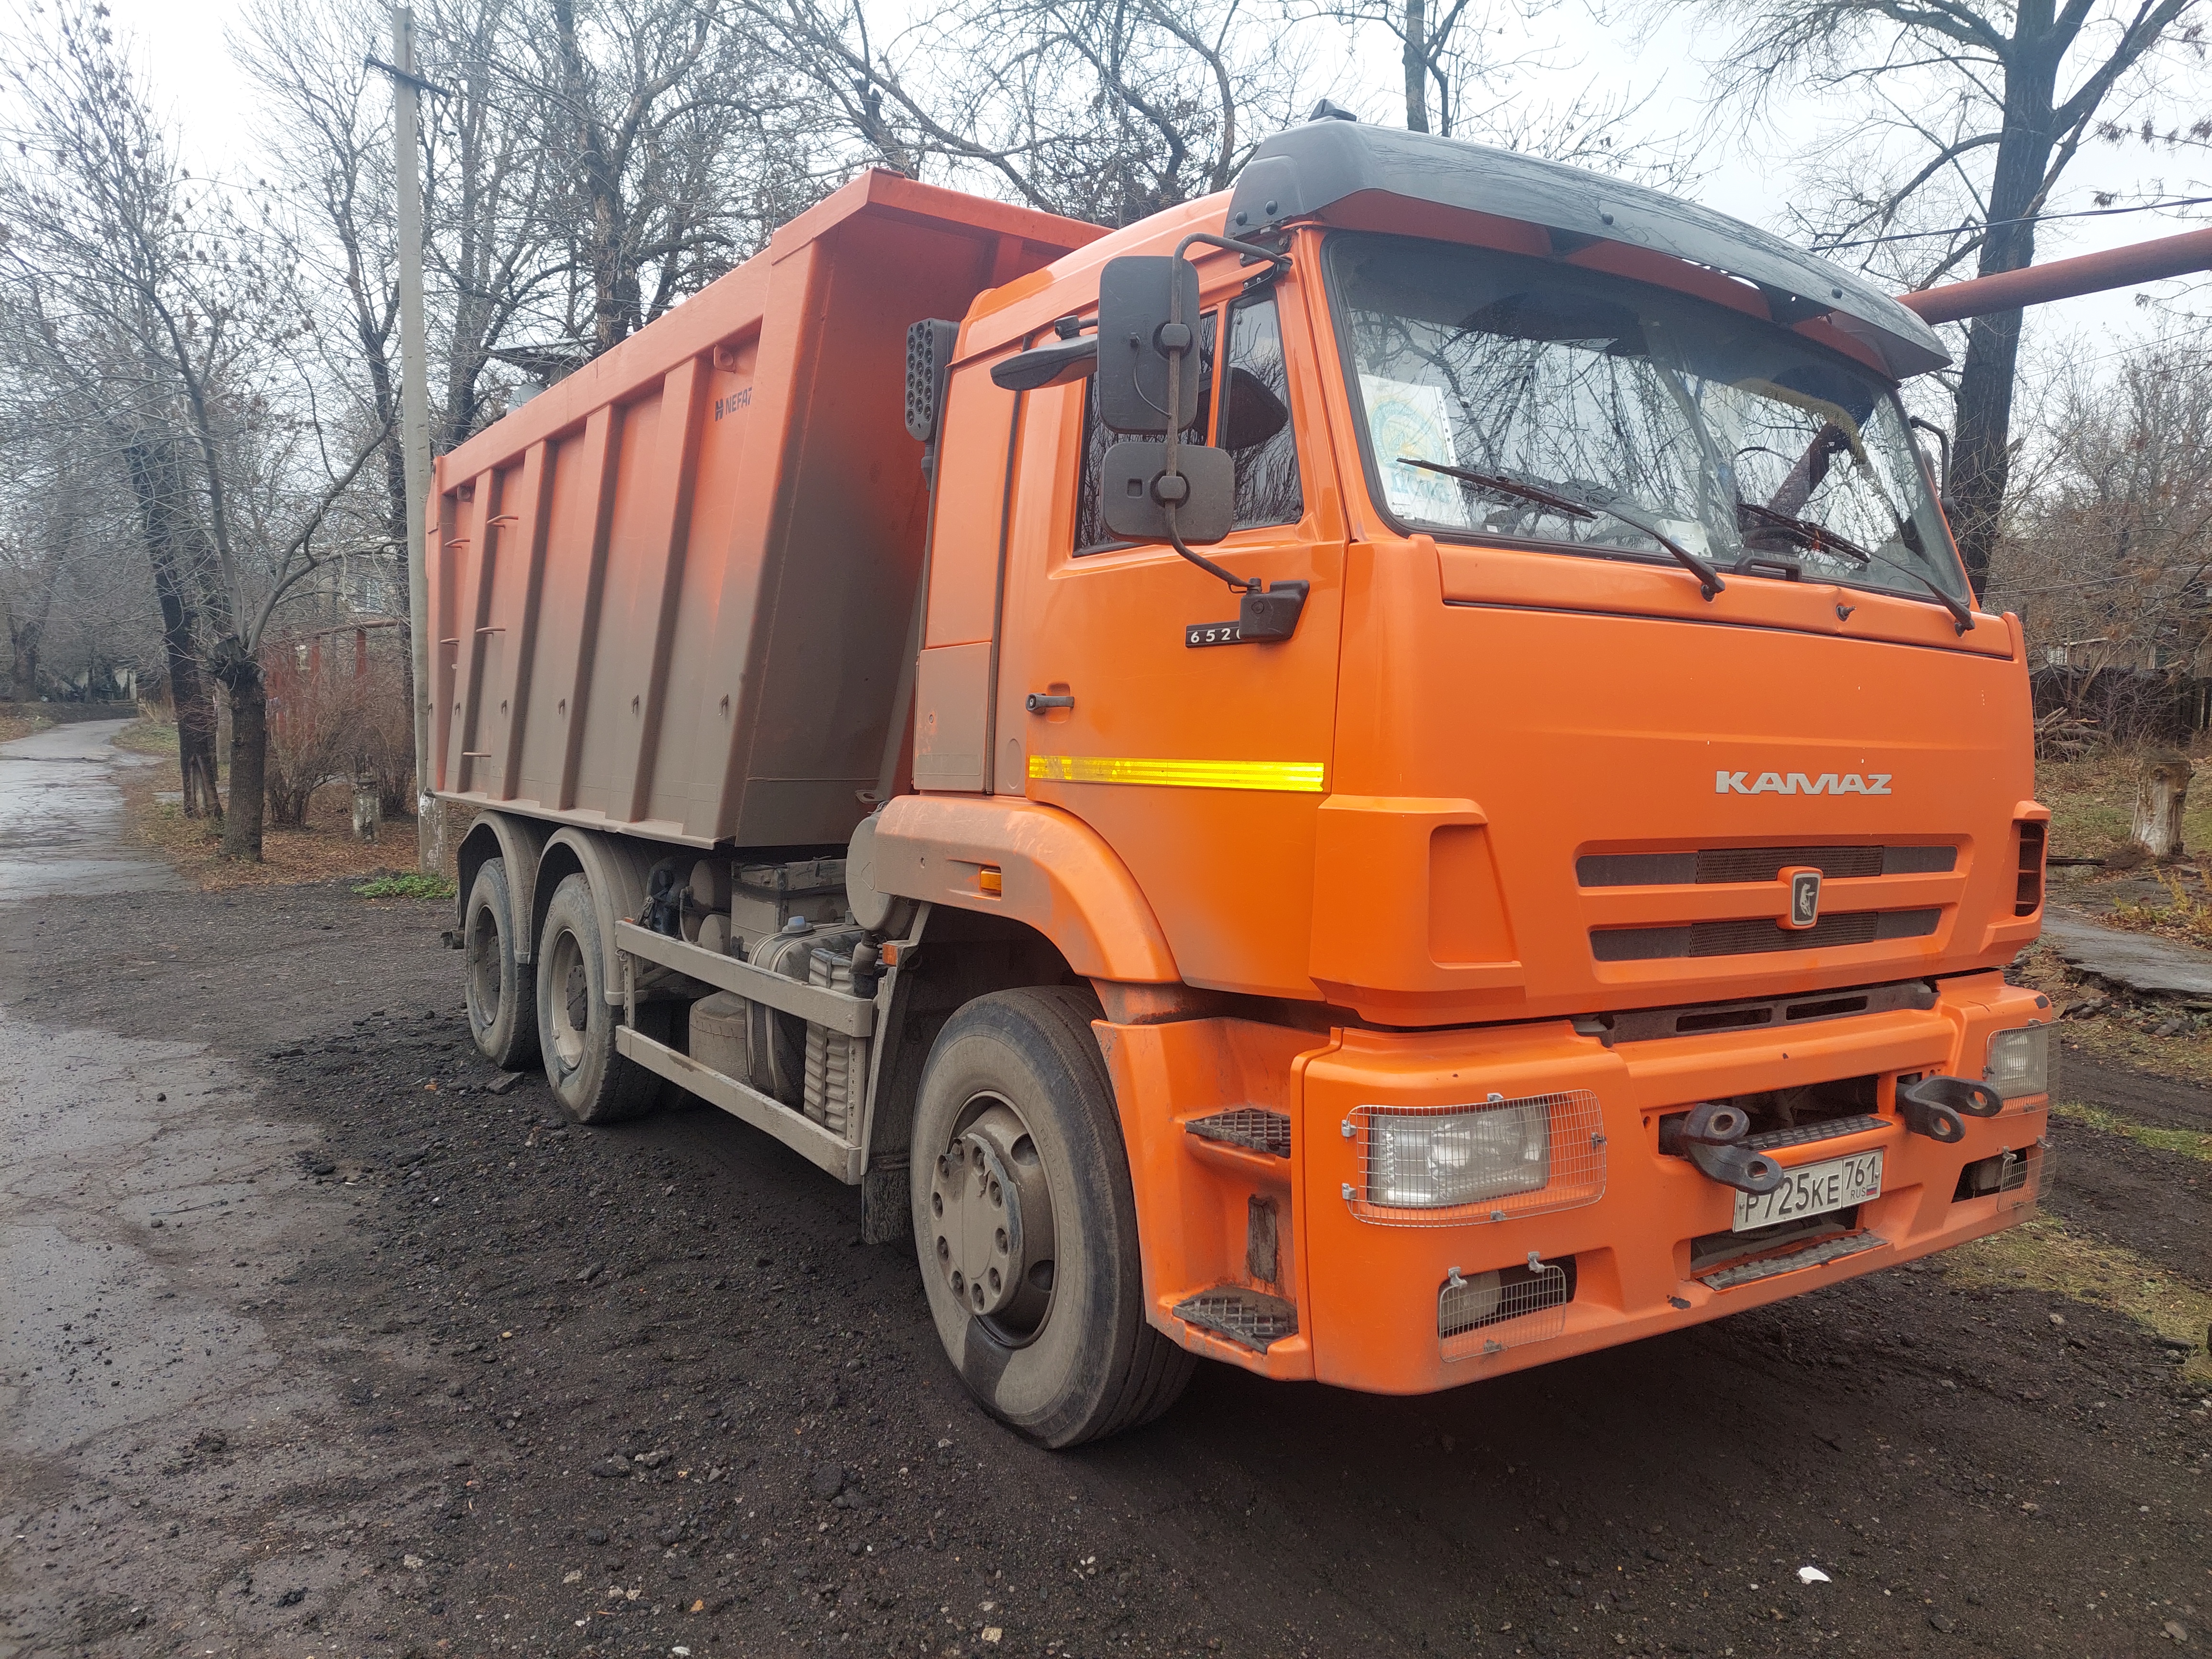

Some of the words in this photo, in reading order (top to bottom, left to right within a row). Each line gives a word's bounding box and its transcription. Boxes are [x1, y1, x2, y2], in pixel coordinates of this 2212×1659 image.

[1715, 771, 1892, 795] KAMAZ
[1845, 1156, 1876, 1190] 761
[1850, 1187, 1866, 1200] RUS
